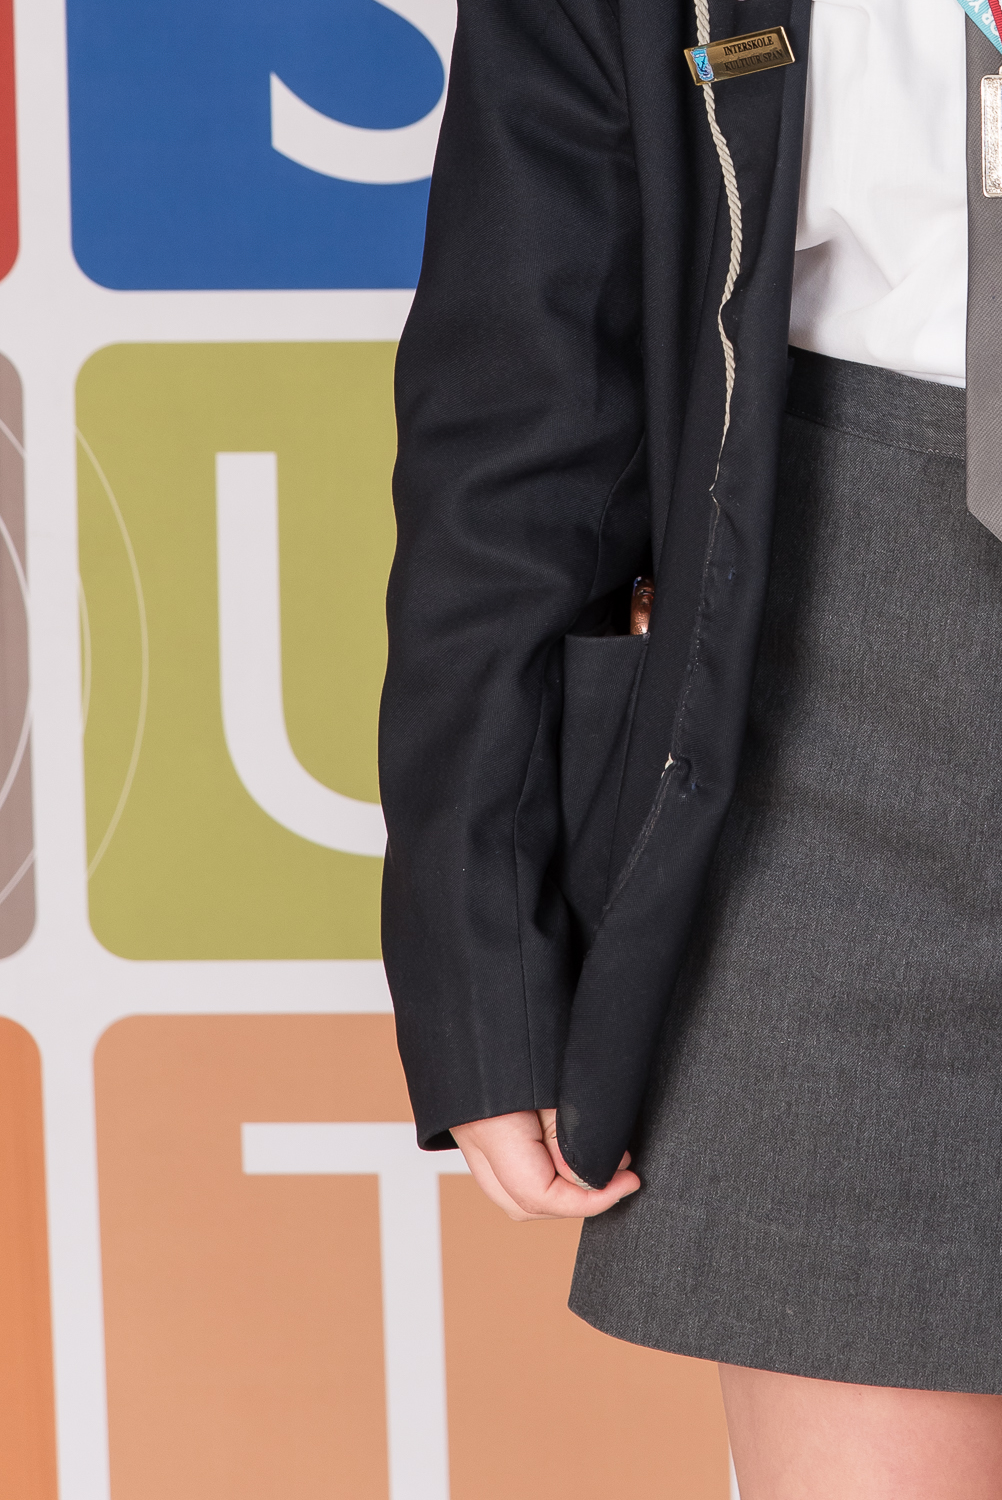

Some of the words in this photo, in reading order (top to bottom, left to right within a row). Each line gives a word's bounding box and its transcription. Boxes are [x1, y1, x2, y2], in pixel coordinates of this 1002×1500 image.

[723, 35, 774, 56] INTERSKOLE
[724, 54, 762, 71] KULTUUR
[763, 49, 784, 62] SPAN
[242, 1122, 470, 1500] T
